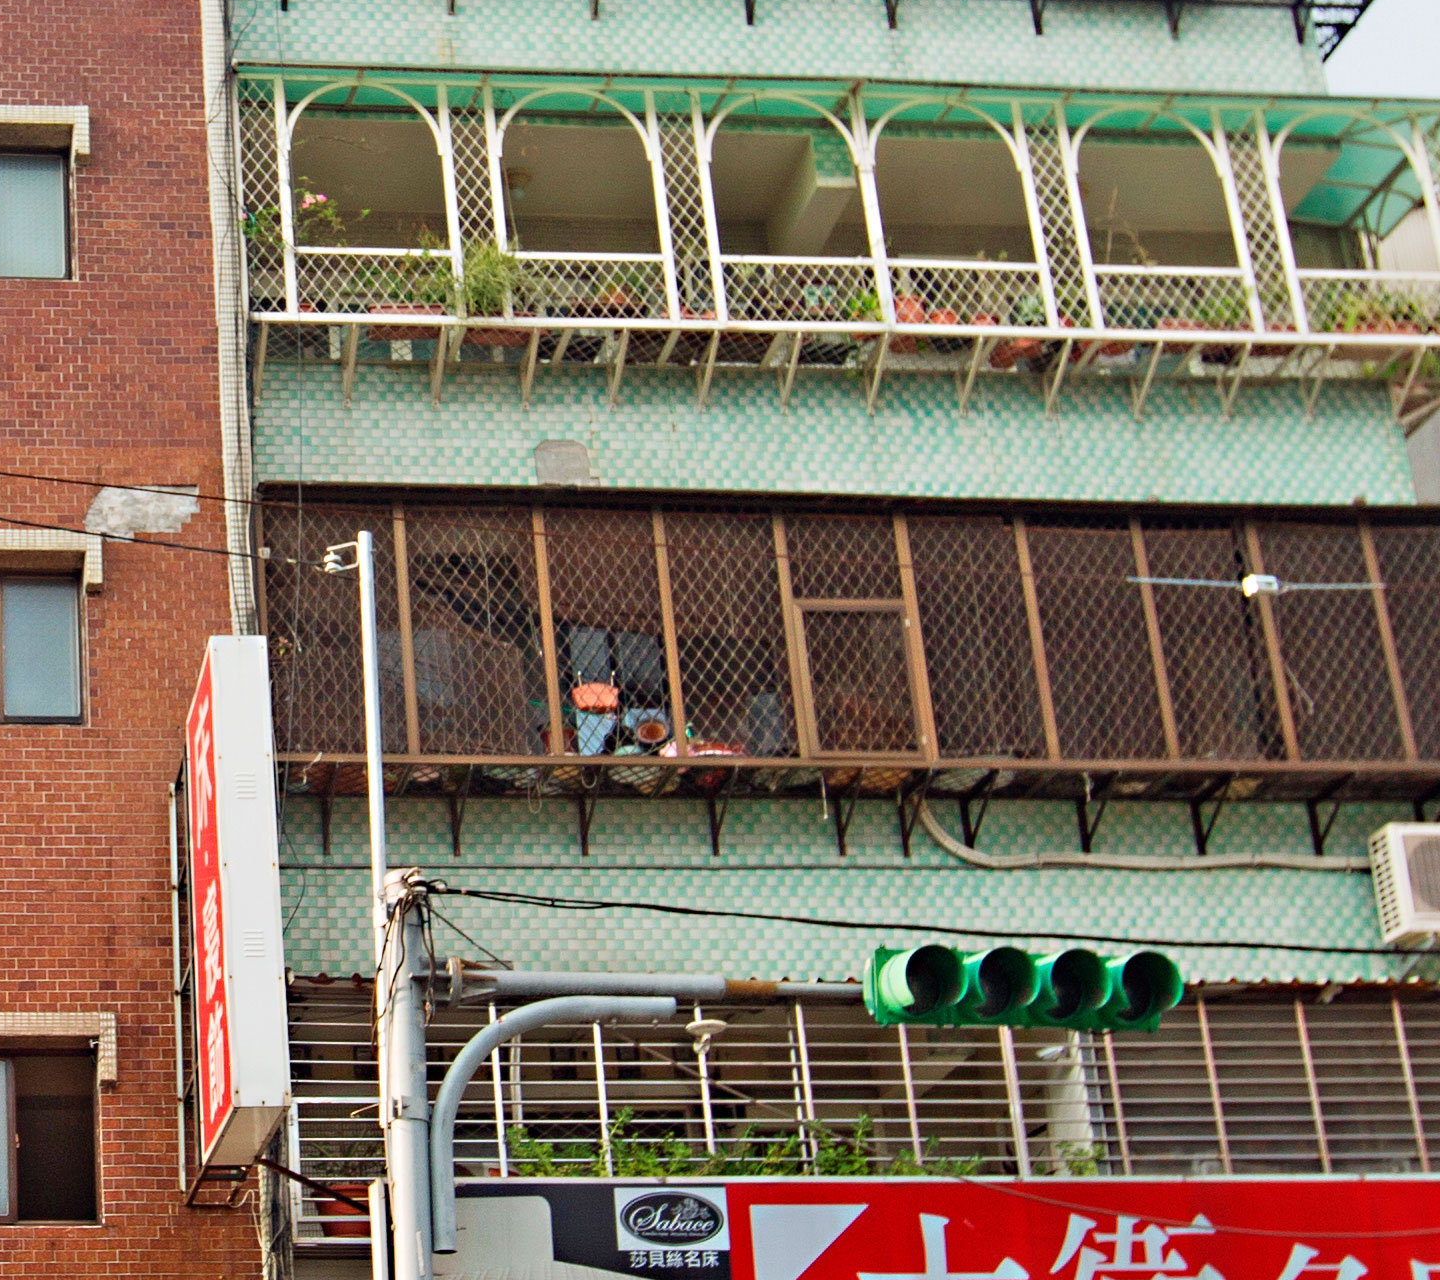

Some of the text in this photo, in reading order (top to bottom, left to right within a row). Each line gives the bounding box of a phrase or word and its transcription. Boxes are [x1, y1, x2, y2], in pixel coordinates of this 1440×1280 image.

[630, 1250, 719, 1268] 莎貝絲名床
